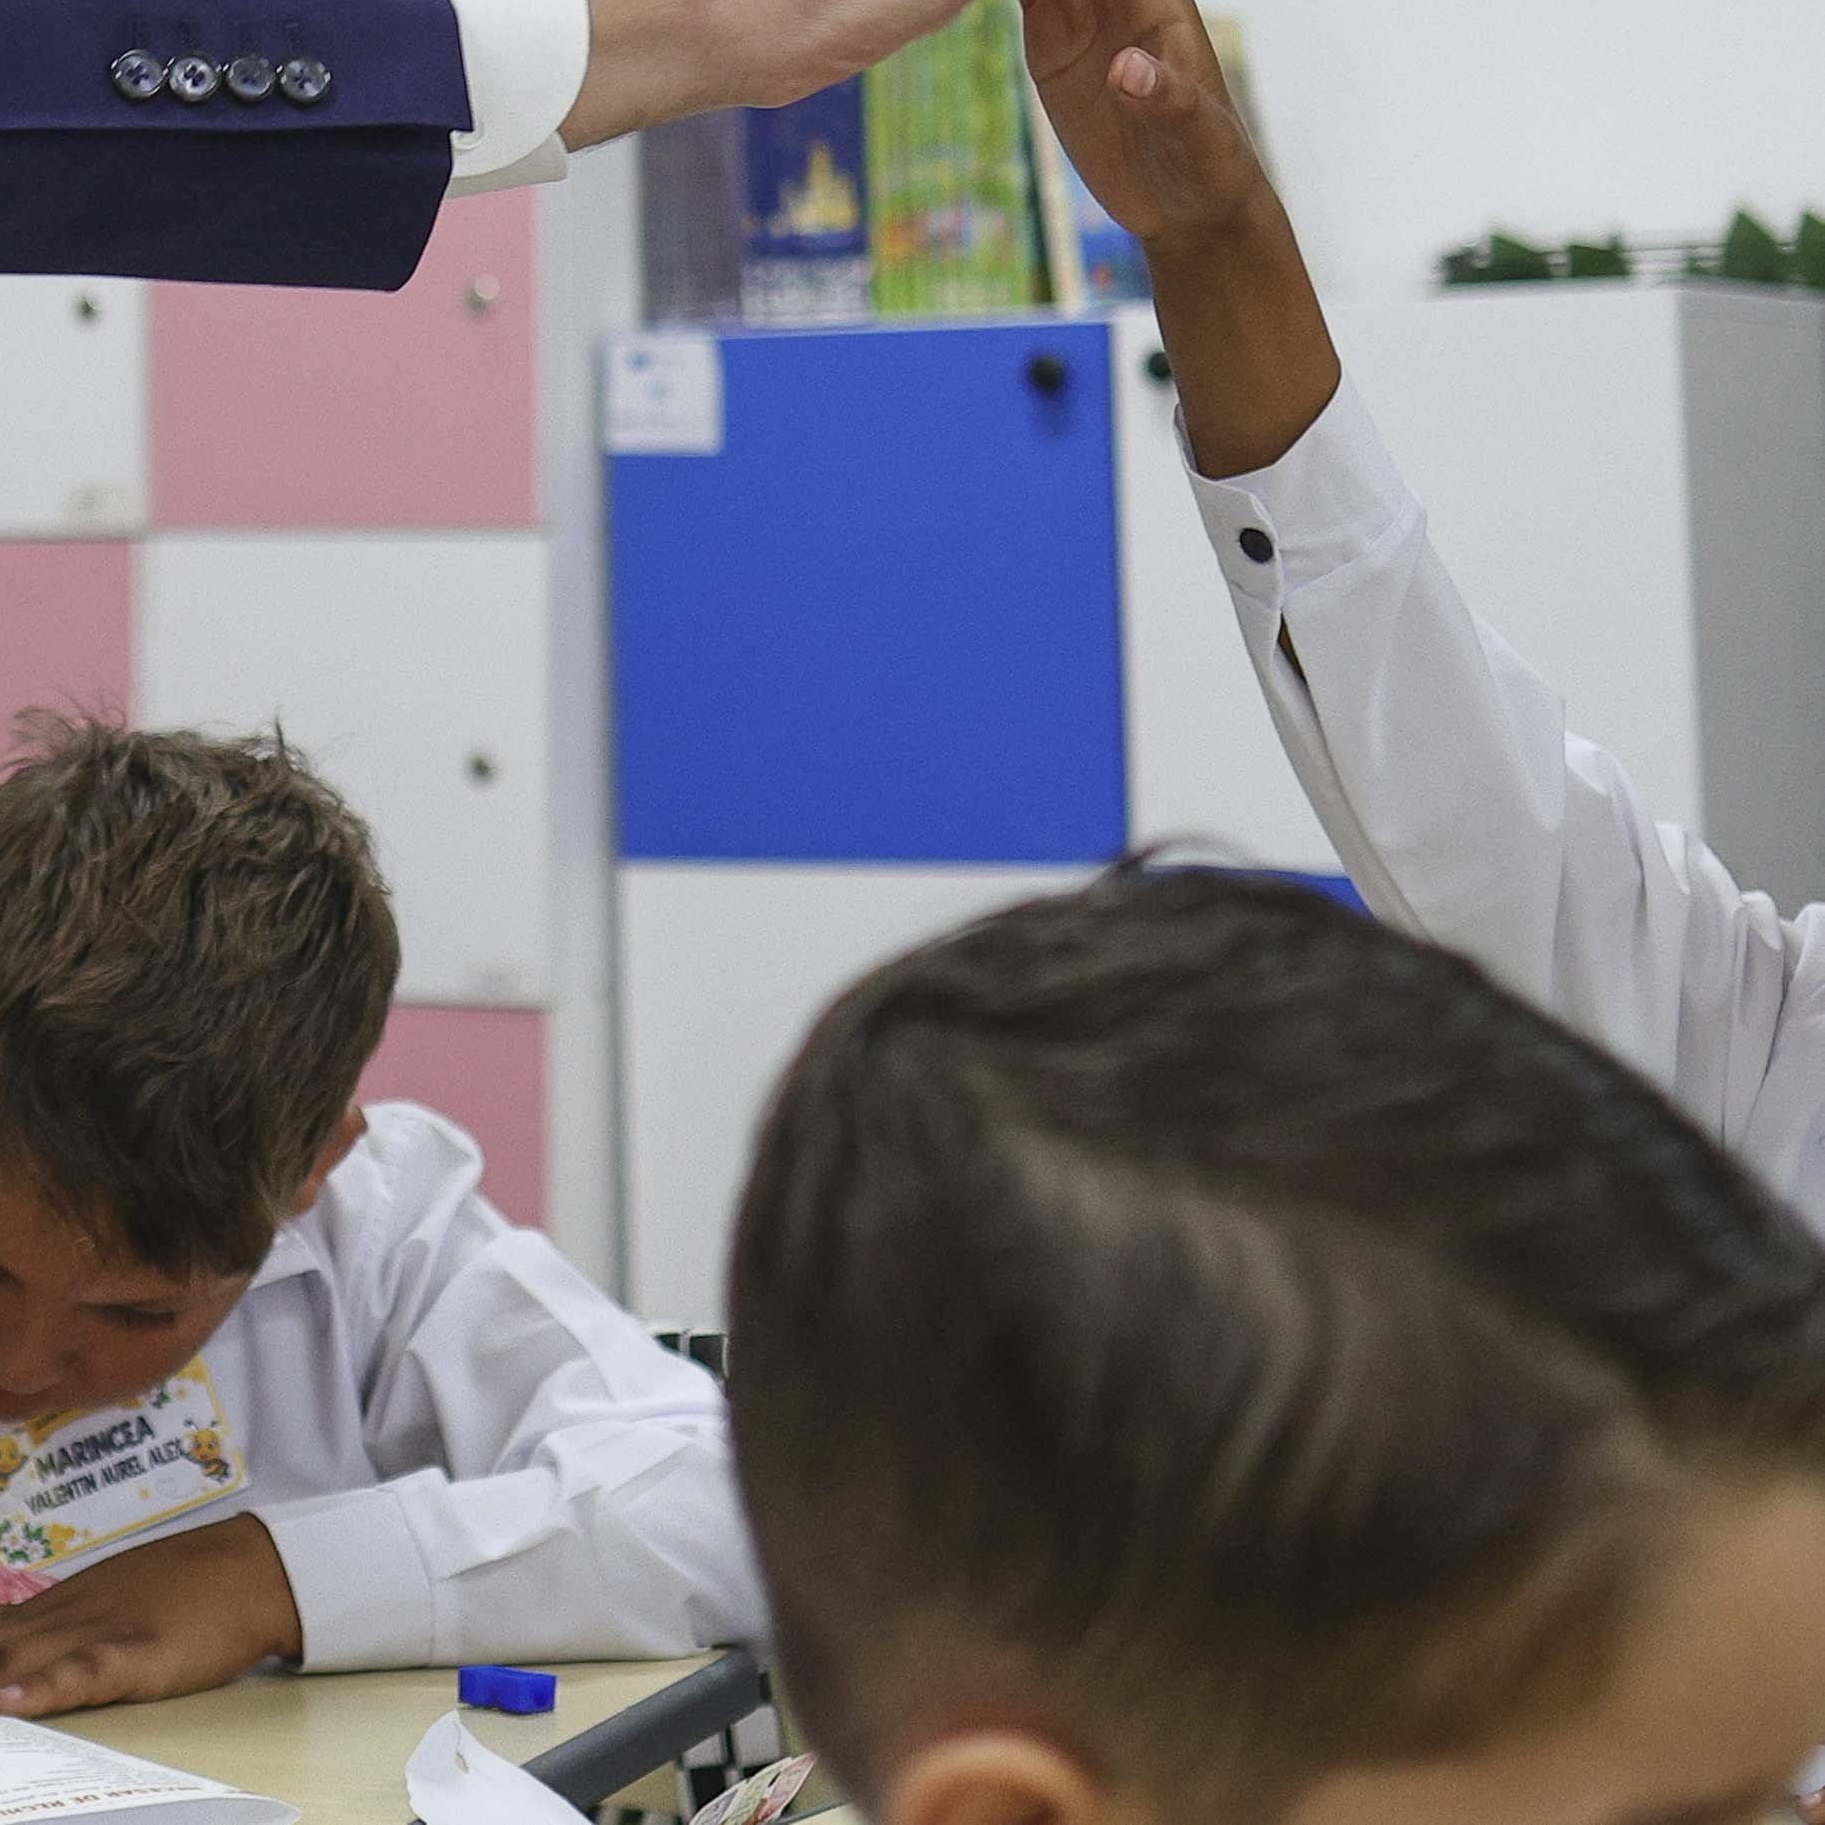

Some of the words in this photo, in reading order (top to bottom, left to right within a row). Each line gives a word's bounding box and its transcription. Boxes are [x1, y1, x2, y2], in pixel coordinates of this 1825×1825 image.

[34, 1415, 155, 1481] MARINCEA
[24, 1472, 99, 1517] VALENTIN
[101, 1455, 146, 1486] AUREL
